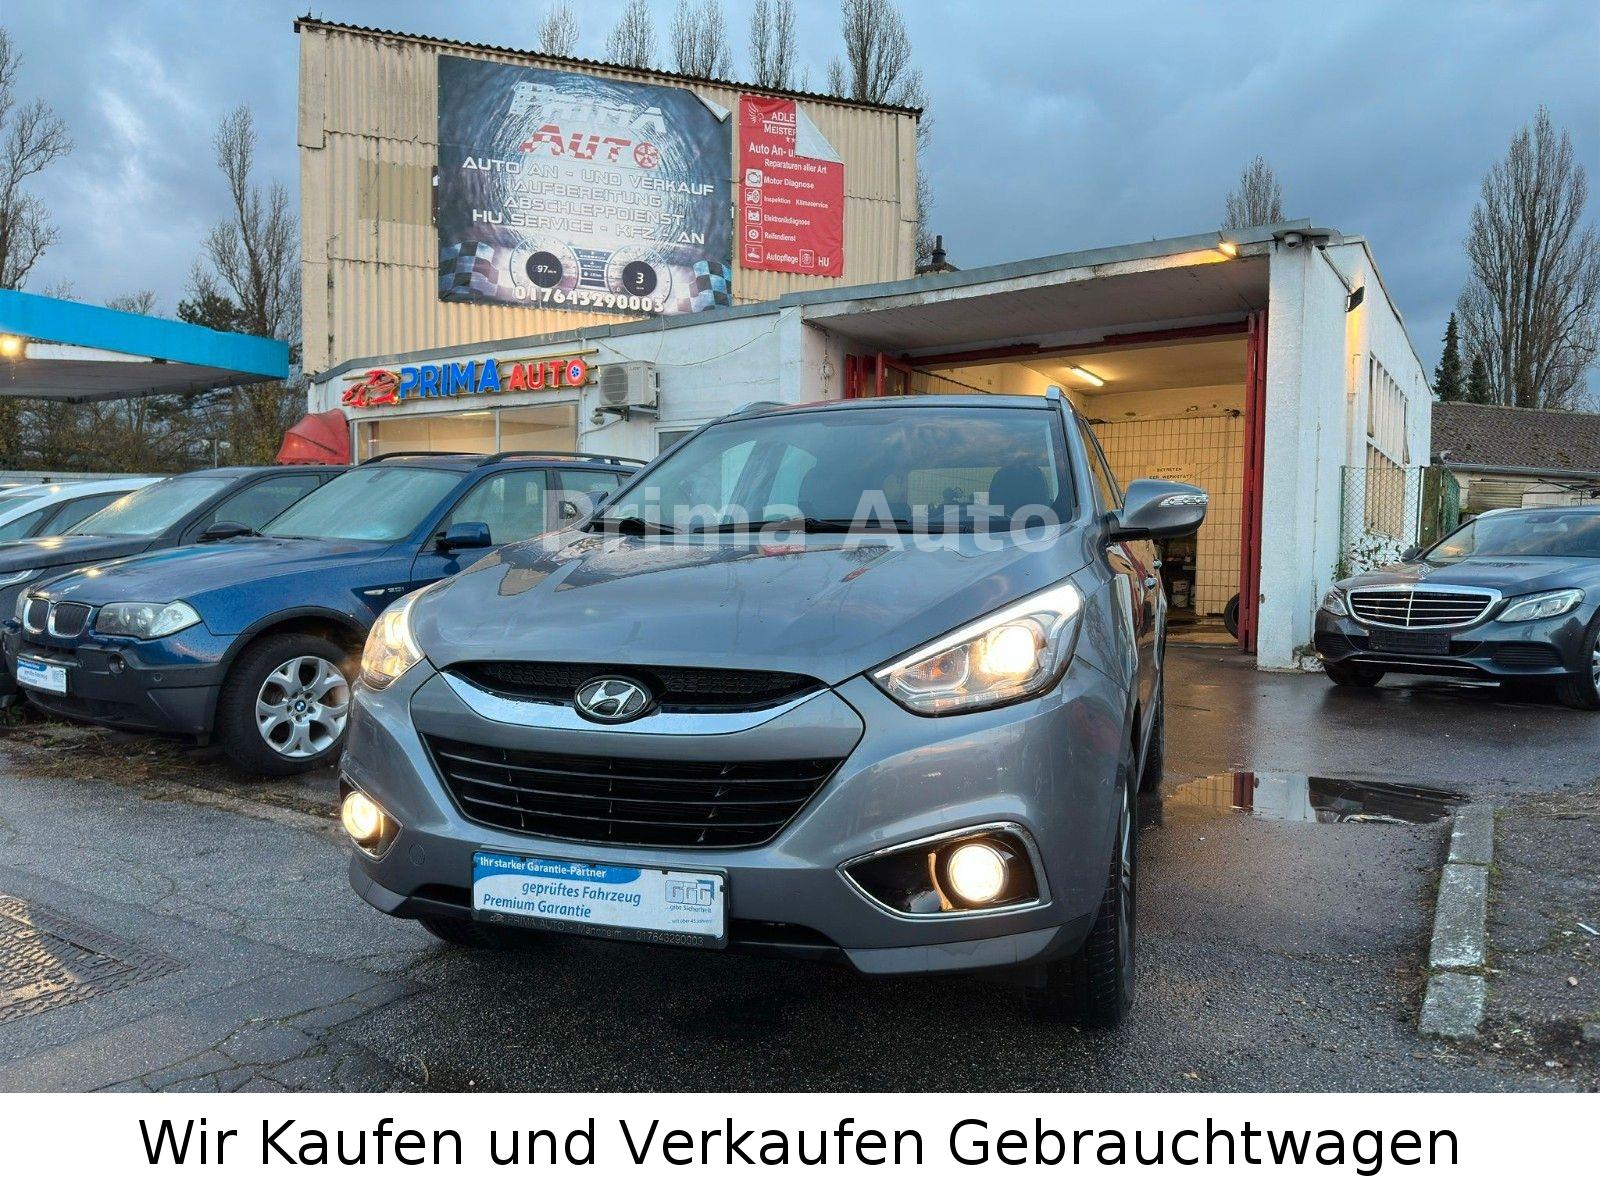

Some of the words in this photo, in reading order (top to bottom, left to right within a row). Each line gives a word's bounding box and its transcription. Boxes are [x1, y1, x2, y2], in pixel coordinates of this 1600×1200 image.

[771, 111, 796, 123] ADLE
[518, 124, 661, 169] AUTO
[749, 142, 770, 154] Auto
[462, 156, 520, 174] AUTO
[528, 163, 559, 179] AN
[581, 169, 622, 186] UND
[629, 174, 715, 196] VERKAUF
[764, 158, 802, 171] Reparaturen
[803, 163, 817, 173] aller
[817, 165, 828, 174] Art
[514, 180, 662, 207] AUFBEREITUNG
[763, 176, 783, 186] Motor
[784, 178, 815, 189] Diagnose
[503, 196, 686, 226] ABSCHLEPPDIENST
[763, 196, 791, 205] Inspektion
[795, 199, 829, 209] Klimaservice
[472, 209, 503, 224] HU
[510, 213, 594, 234] SERVICE
[616, 223, 656, 240] KFZ
[677, 231, 705, 245] AN
[764, 231, 797, 242] Reifendienst
[766, 252, 799, 264] Autopflege
[818, 256, 830, 267] HU
[636, 272, 644, 284] 3
[513, 285, 665, 313] 017643290003
[400, 359, 501, 399] PRIMA
[508, 359, 588, 391] AUTO
[480, 856, 494, 867] Ihr
[494, 859, 526, 870] starker
[527, 861, 606, 878] Garantie-Partner
[522, 881, 580, 896] geprüftes
[582, 886, 642, 907] Fahrzeug
[483, 893, 535, 911] Premium
[537, 900, 592, 918] Garantie
[539, 918, 565, 931] AUTO
